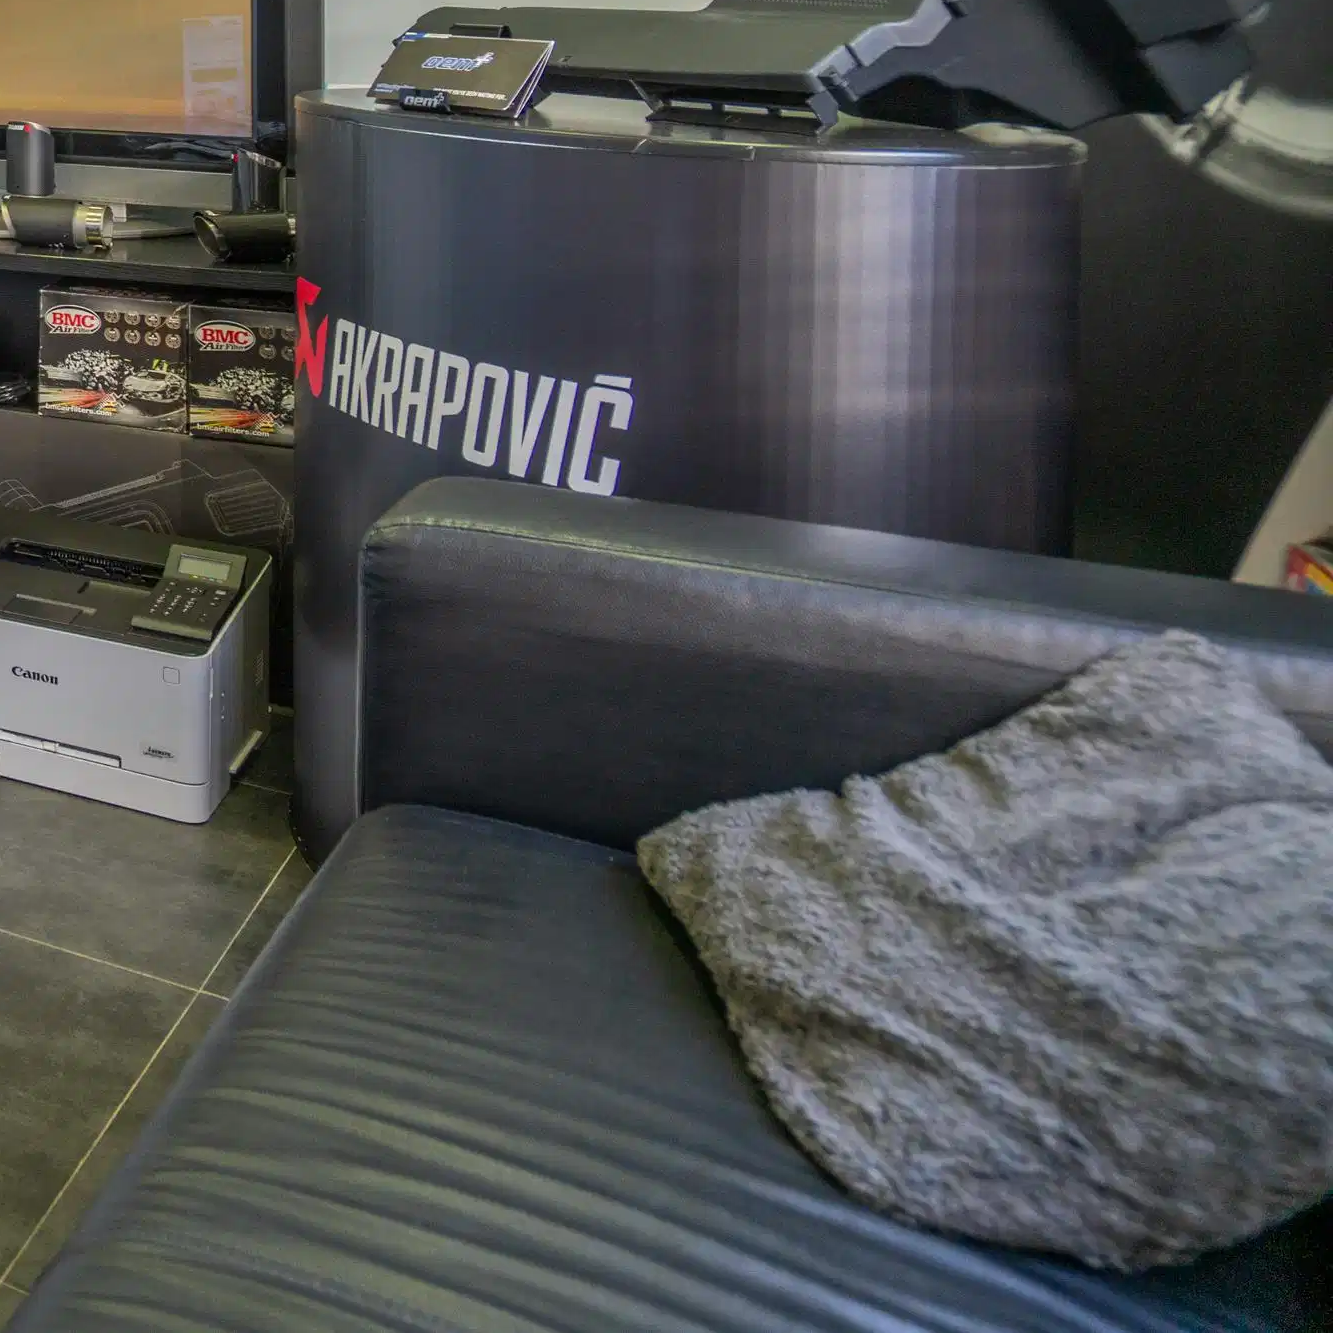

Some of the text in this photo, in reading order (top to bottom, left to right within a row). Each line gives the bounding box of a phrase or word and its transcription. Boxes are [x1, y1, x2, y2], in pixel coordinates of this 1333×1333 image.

[52, 312, 95, 329] BMC
[201, 328, 249, 345] BMC
[196, 423, 271, 438] bmcairfilters.com
[11, 665, 60, 686] Canon
